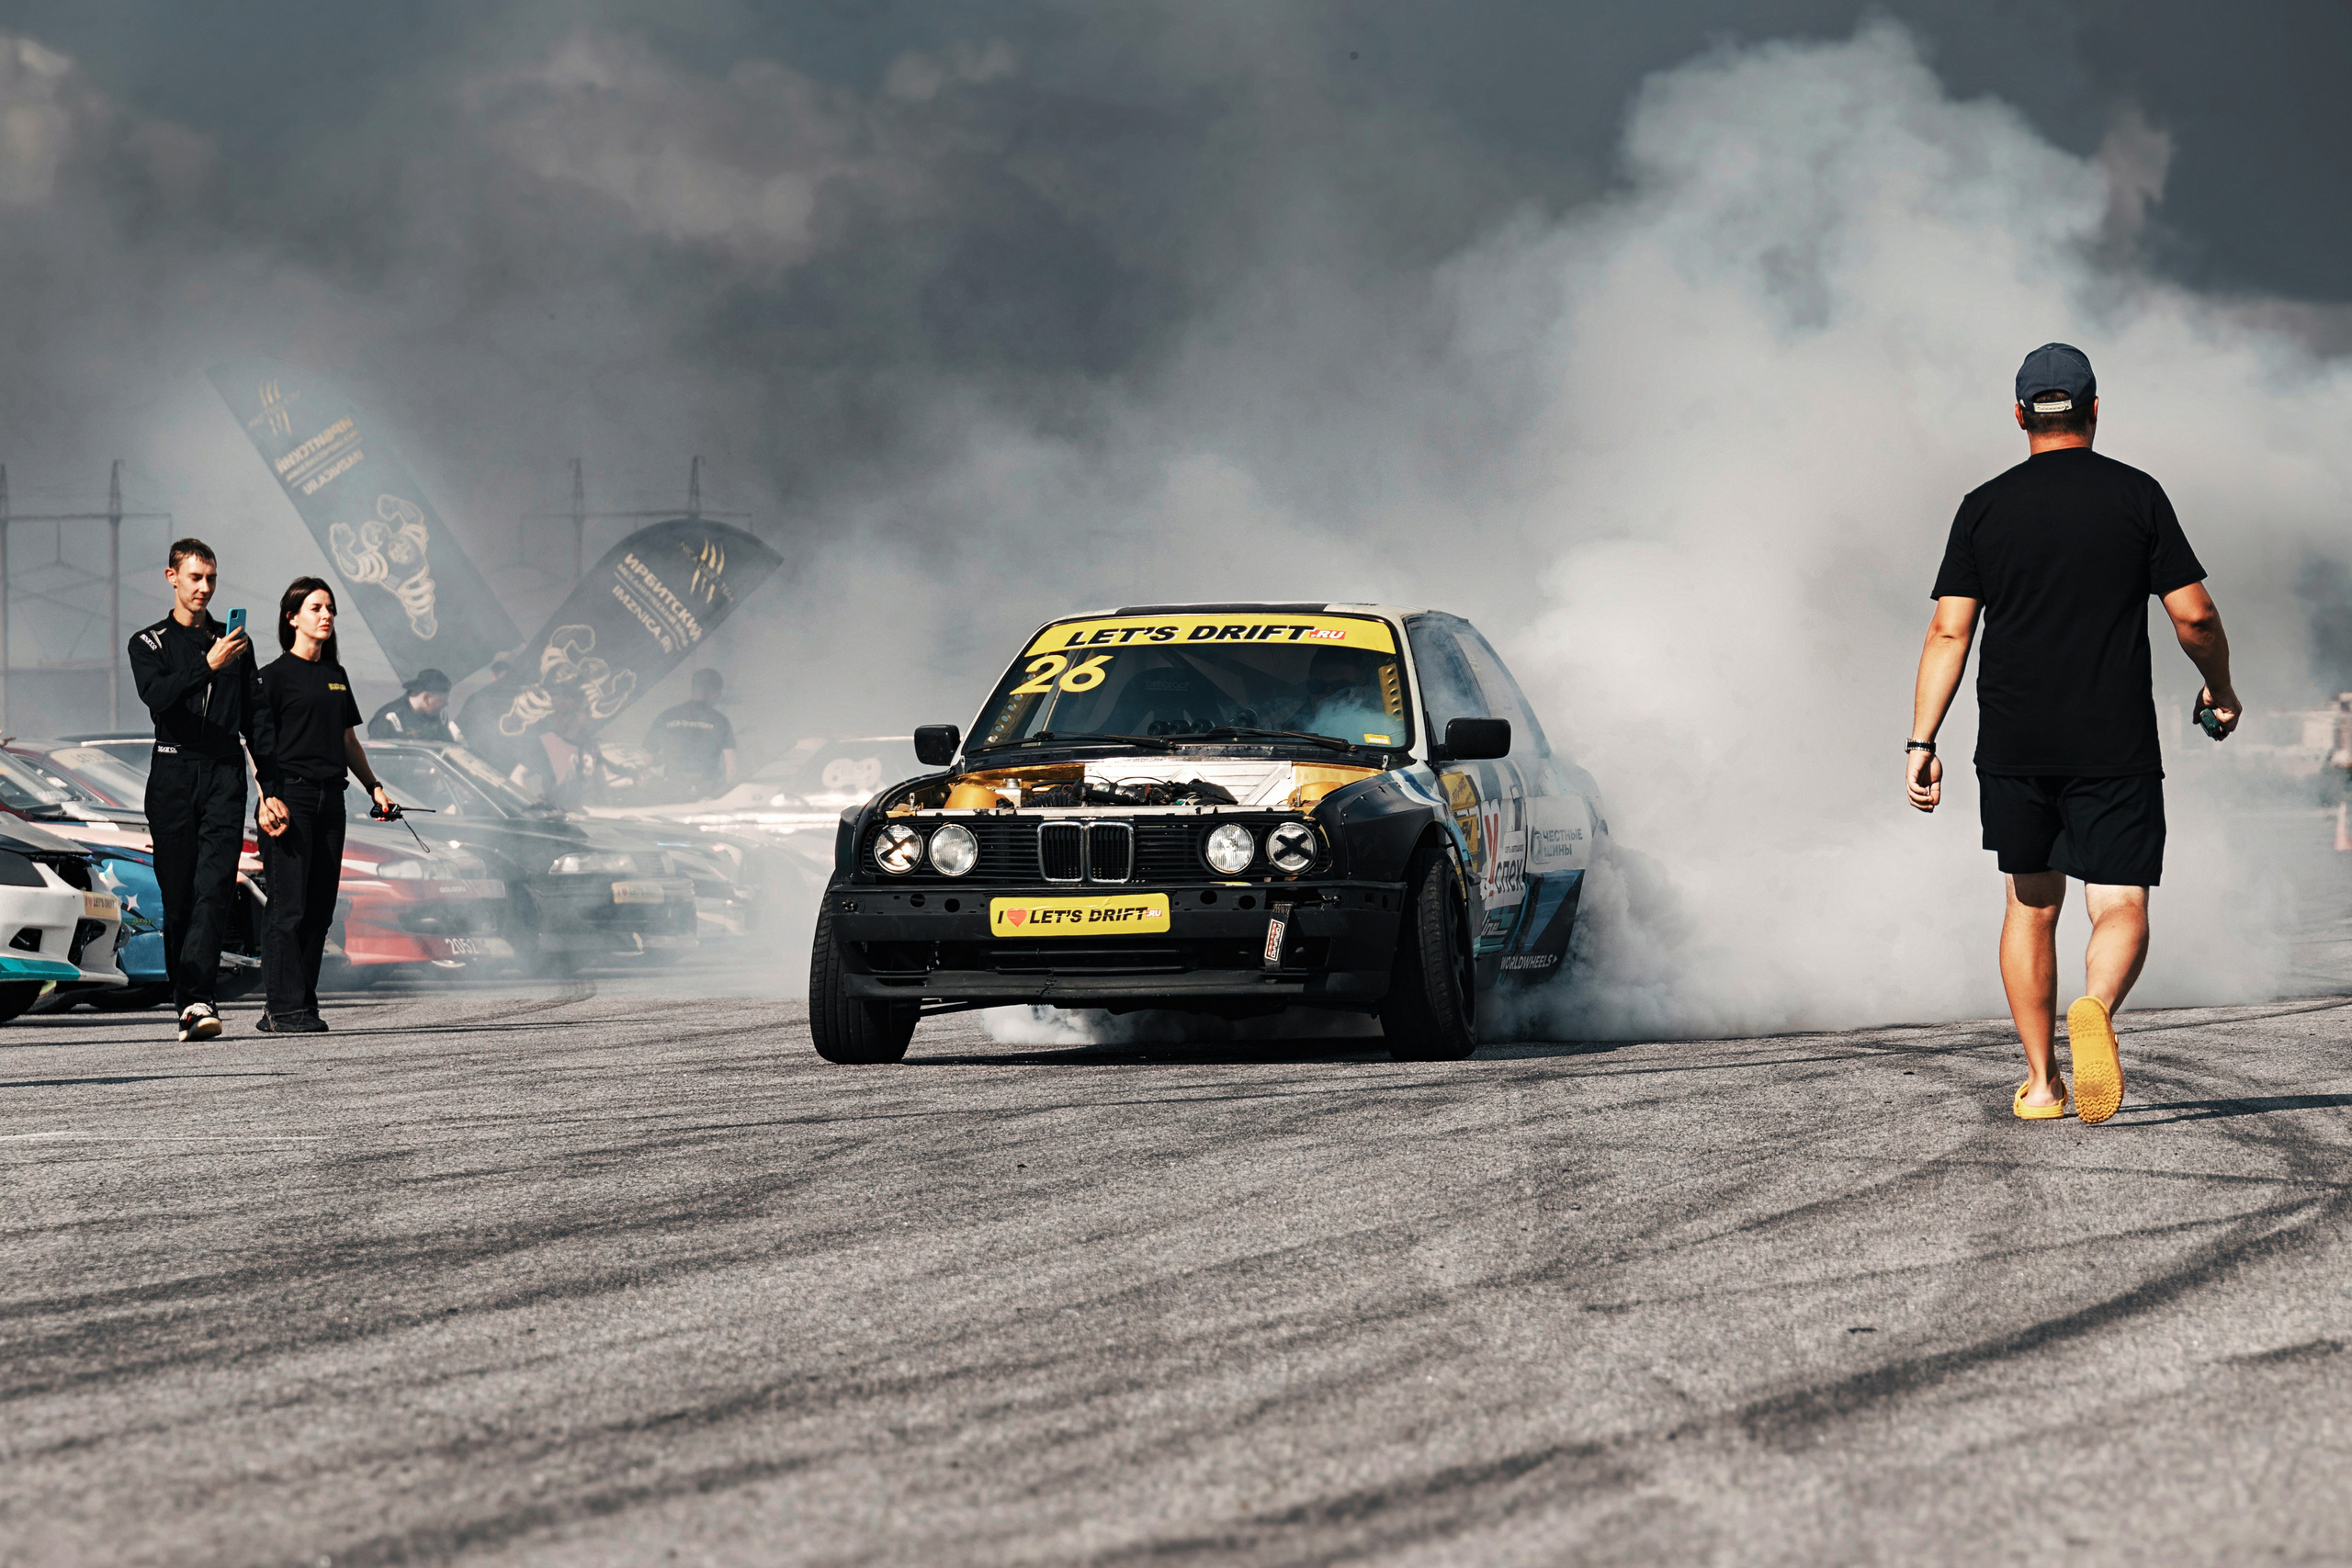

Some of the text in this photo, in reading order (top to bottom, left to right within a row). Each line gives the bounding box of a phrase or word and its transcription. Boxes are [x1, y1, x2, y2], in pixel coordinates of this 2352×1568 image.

[1064, 626, 1180, 648] LET'S
[1009, 654, 1114, 695] 26
[1543, 828, 1583, 842] ЧЕСТНЫЕ
[1544, 843, 1572, 857] ШИНЫ
[997, 910, 1004, 924] I
[1029, 909, 1083, 924] LET'S
[445, 938, 481, 955] 2052
[1271, 923, 1283, 959] FORWARD
[1500, 953, 1554, 970] WORLDWHEELS
